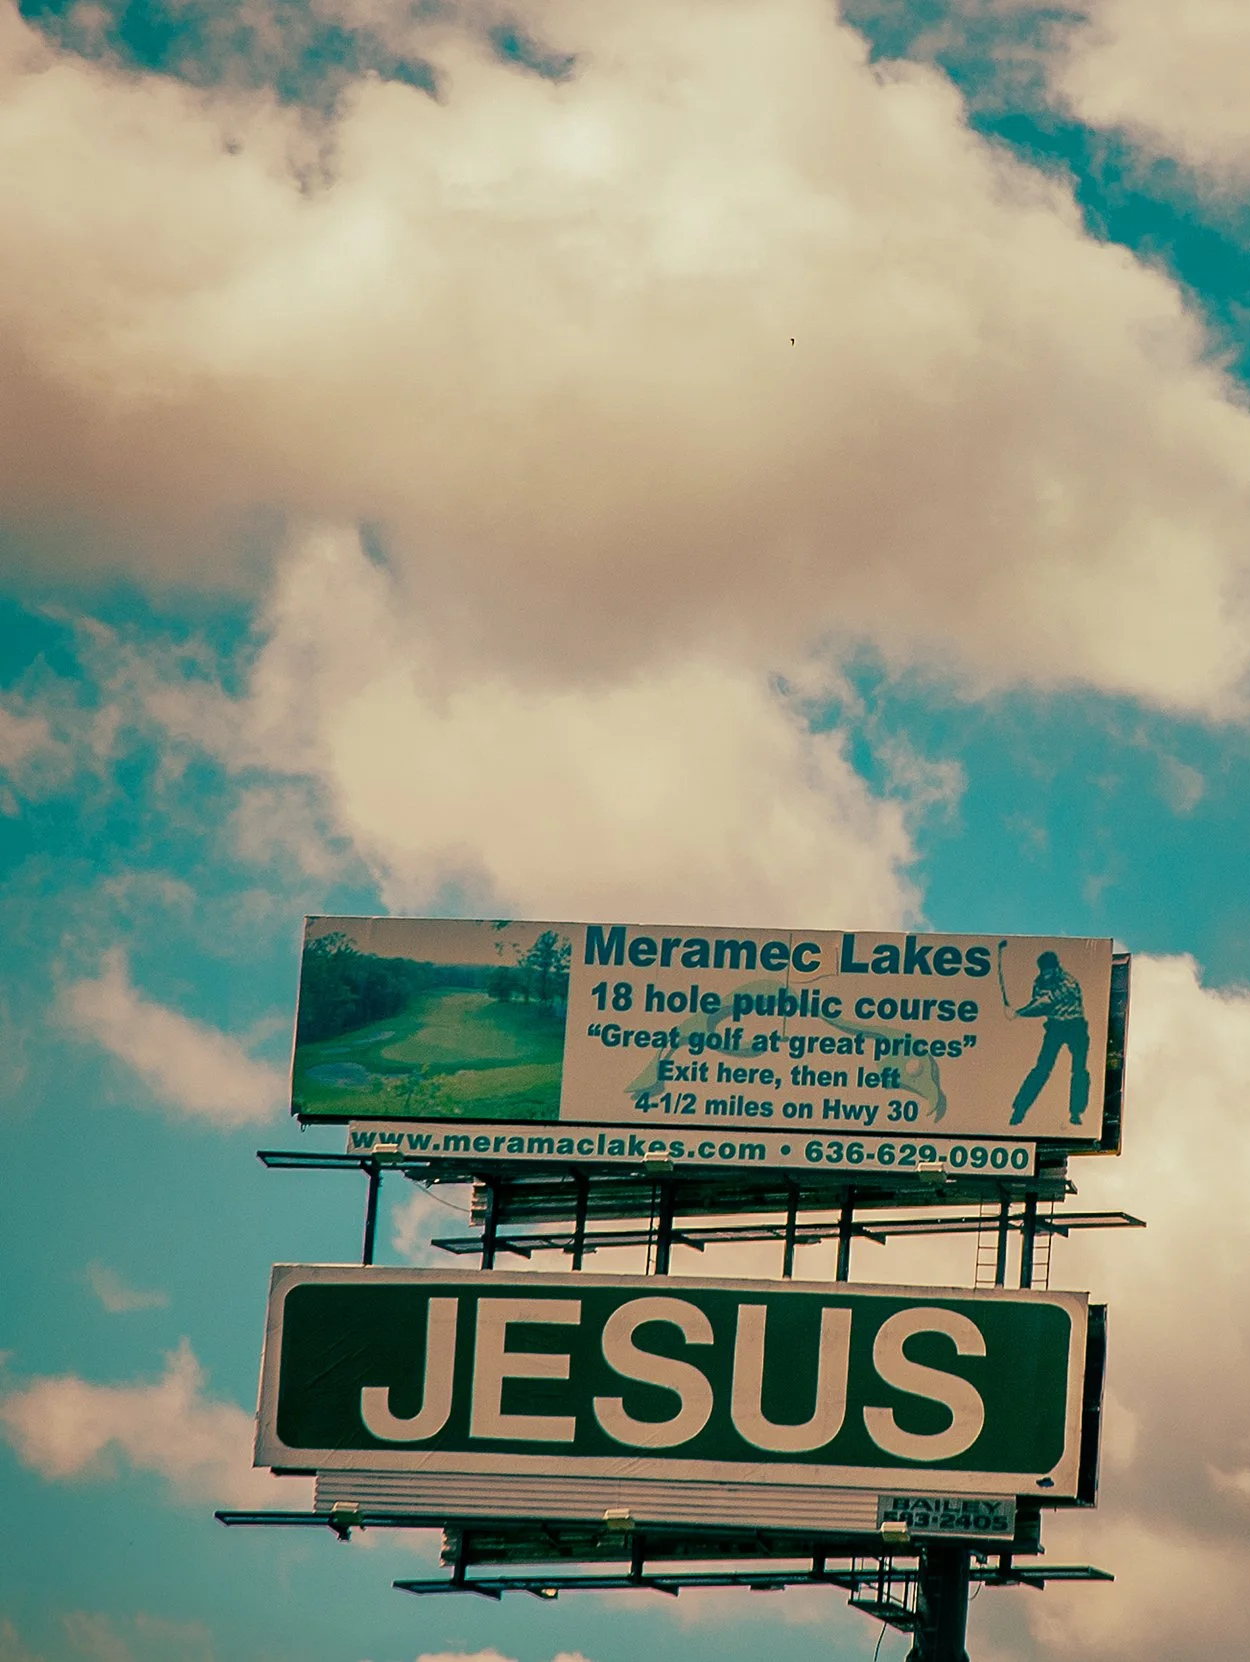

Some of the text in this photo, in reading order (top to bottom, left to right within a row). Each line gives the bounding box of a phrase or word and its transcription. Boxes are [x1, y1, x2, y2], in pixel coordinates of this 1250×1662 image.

[584, 925, 991, 977] Meramec Lakes
[591, 981, 979, 1023] 18 hole public course
[688, 1027, 744, 1055] golf
[751, 1030, 780, 1052] at
[788, 1032, 865, 1059] great
[657, 1060, 900, 1090] Exit here, then left
[634, 1092, 919, 1126] 4-1/2 miles on Hwy 30
[350, 1130, 1030, 1170] www.meramaclakes.com 636-629-0900
[360, 1296, 987, 1461] JESUS
[892, 1498, 1001, 1514] BAILEY
